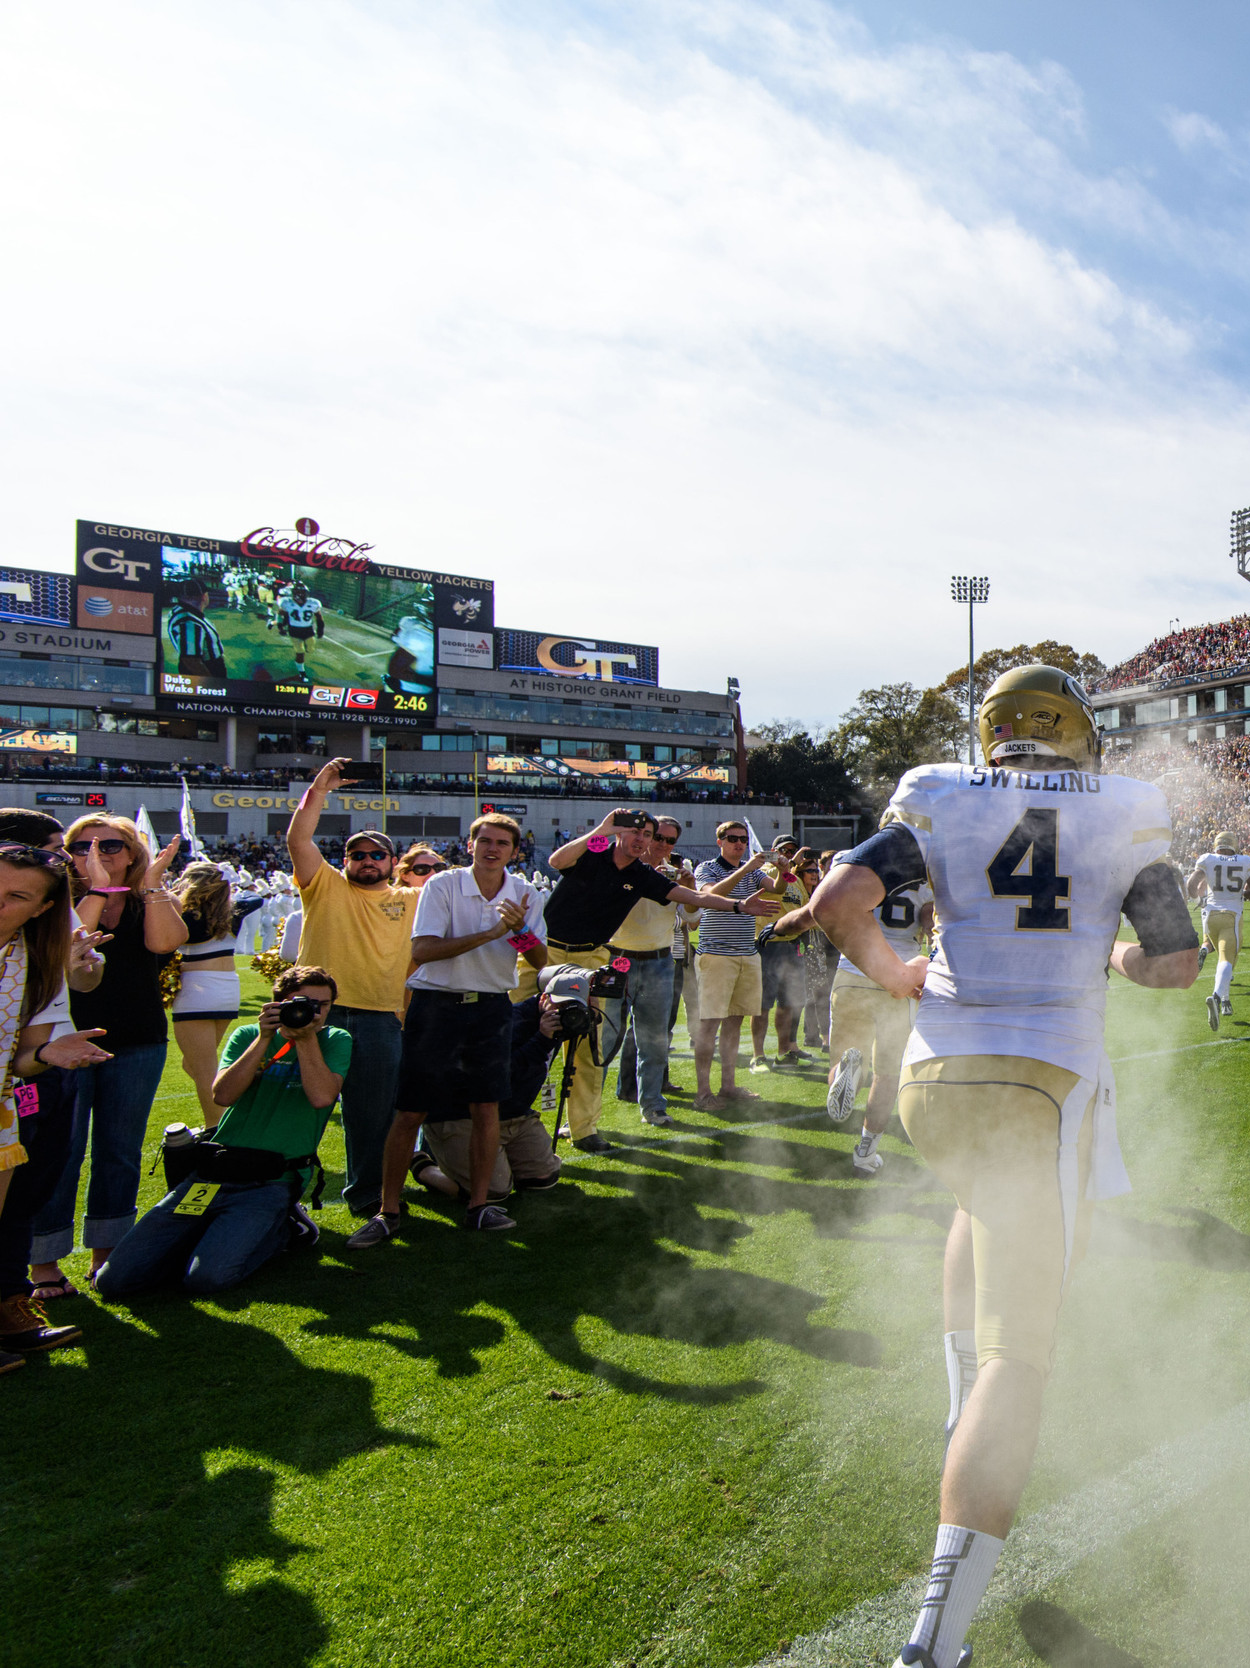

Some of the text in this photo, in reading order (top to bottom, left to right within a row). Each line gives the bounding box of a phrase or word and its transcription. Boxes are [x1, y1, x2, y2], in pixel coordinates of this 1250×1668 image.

[94, 524, 220, 551] GEORGIA TECH
[83, 547, 151, 581] GT
[378, 565, 493, 591] YELLOW JACKETS
[118, 604, 149, 617] at&t
[15, 631, 112, 651] STADIUM
[441, 640, 476, 649] GEORGIA
[464, 647, 490, 655] POWER
[537, 636, 637, 683] GT
[164, 673, 192, 685] Duke
[164, 683, 227, 697] Wake Forest
[297, 686, 309, 694] PM
[311, 688, 340, 704] GT
[510, 678, 681, 704] AT HISTORIC GRANT FIELD
[393, 694, 428, 712] 2:46
[177, 702, 237, 714] NATIONAL
[243, 706, 312, 719] CHAMPIONS
[395, 717, 418, 726] 1990
[1033, 713, 1052, 721] ACC
[1004, 743, 1036, 753] JACKETS
[969, 767, 1101, 794] SWILLING
[87, 794, 104, 805] 25
[212, 792, 401, 812] Georg Tech
[482, 803, 495, 814] 25
[590, 836, 606, 844] #PG
[984, 806, 1073, 932] 4
[1212, 864, 1244, 893] 15
[511, 933, 529, 944] PG
[19, 1086, 35, 1102] PG
[191, 1189, 208, 1202] 2
